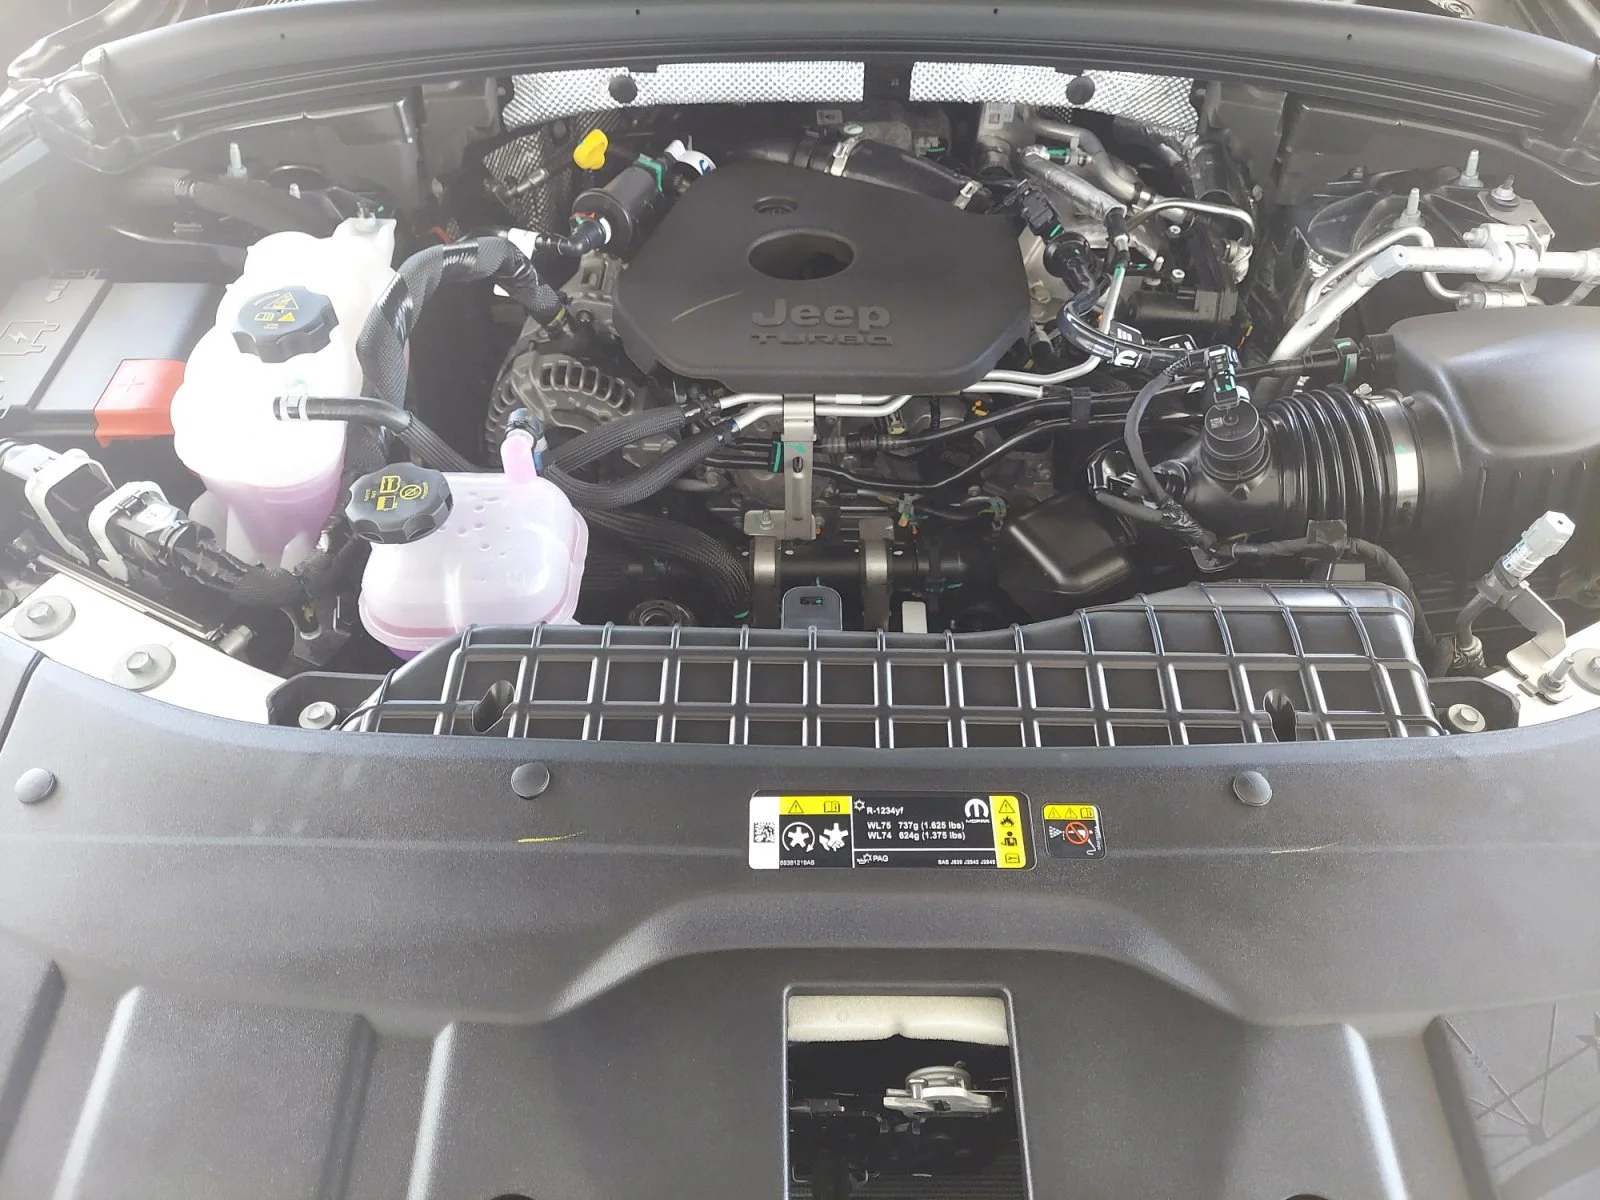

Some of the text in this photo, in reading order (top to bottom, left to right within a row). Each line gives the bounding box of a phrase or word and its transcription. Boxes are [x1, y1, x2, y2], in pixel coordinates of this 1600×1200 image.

[751, 298, 891, 334] Jeep
[751, 333, 894, 347] TURBO
[866, 806, 904, 816] R-1234yf
[867, 821, 965, 831] WL75 737g (1.625 lbs)
[867, 831, 966, 841] WL74 624g (1.375 lbs)
[872, 854, 889, 863] PAG
